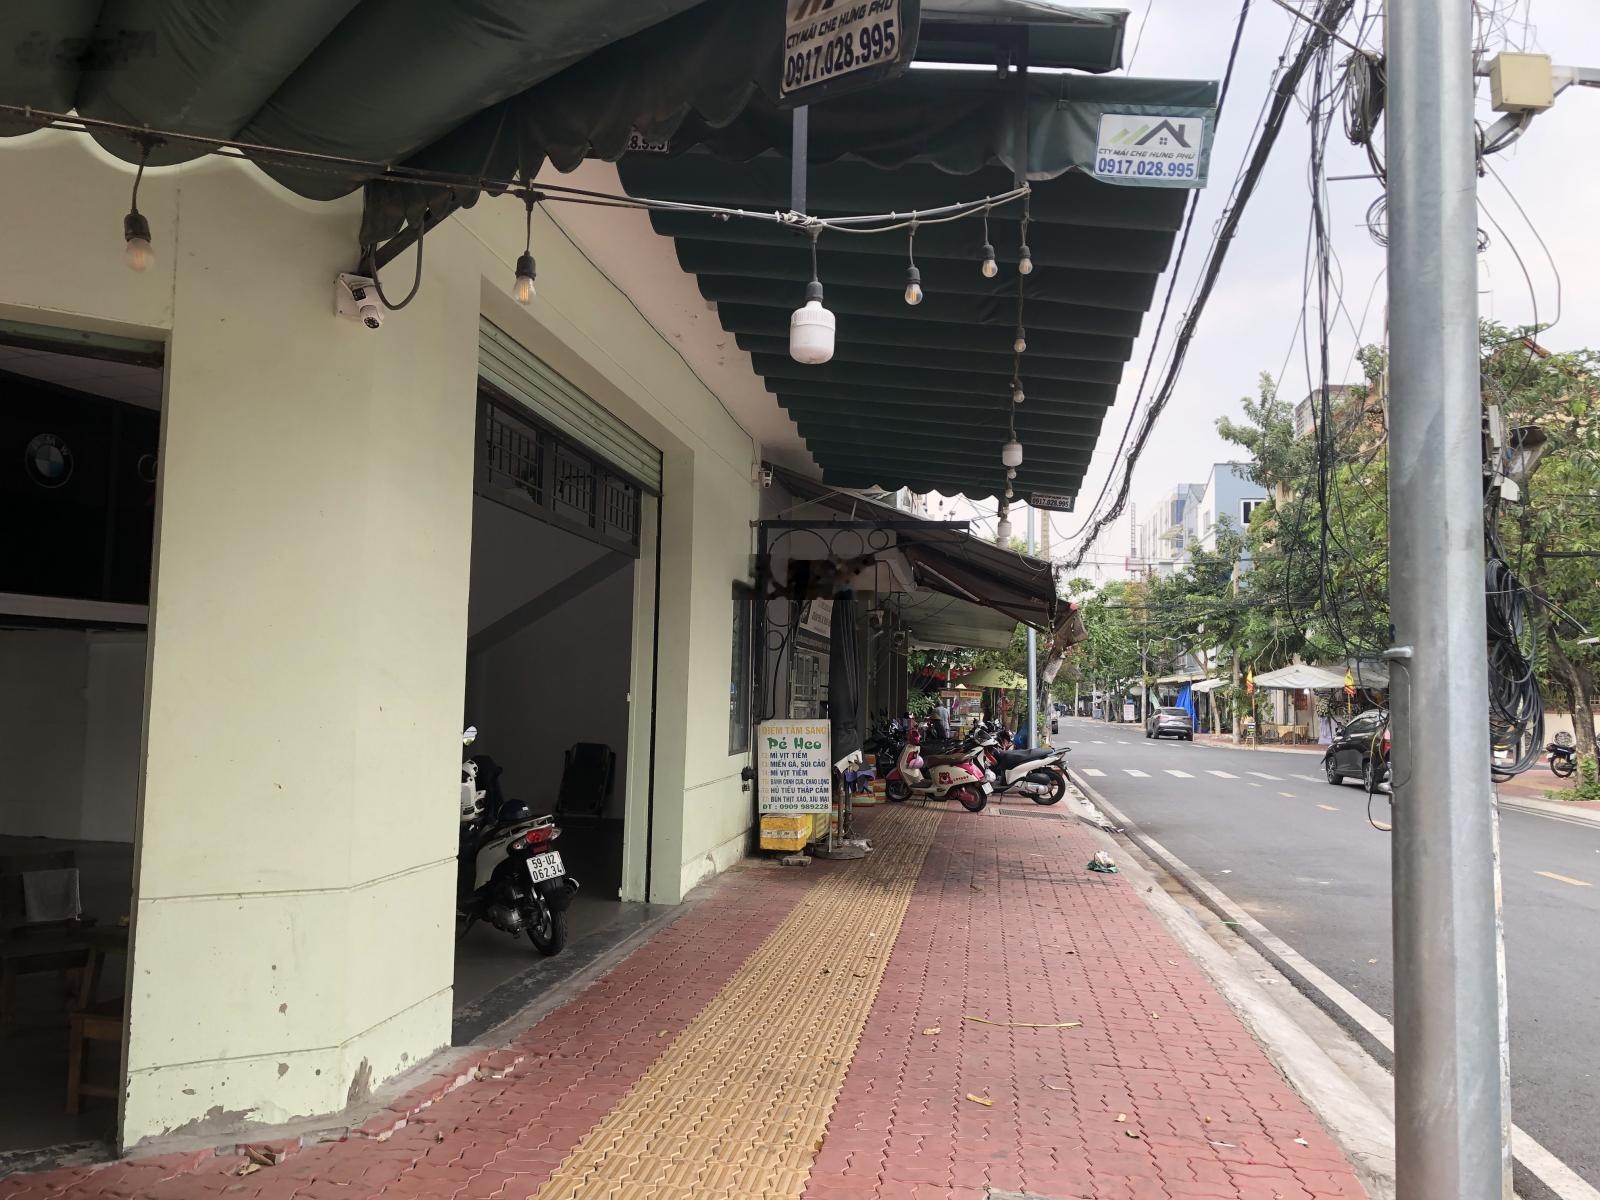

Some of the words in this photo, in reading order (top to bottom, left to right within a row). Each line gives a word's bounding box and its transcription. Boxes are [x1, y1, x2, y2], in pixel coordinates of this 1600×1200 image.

[818, 16, 838, 36] CHE
[786, 19, 896, 87] 0917.028.995
[1098, 157, 1194, 178] 0917.028.995
[779, 752, 790, 760] VỊT
[780, 769, 789, 777] VỊT
[531, 854, 556, 868] 59-U2
[532, 865, 562, 880] 062.34
